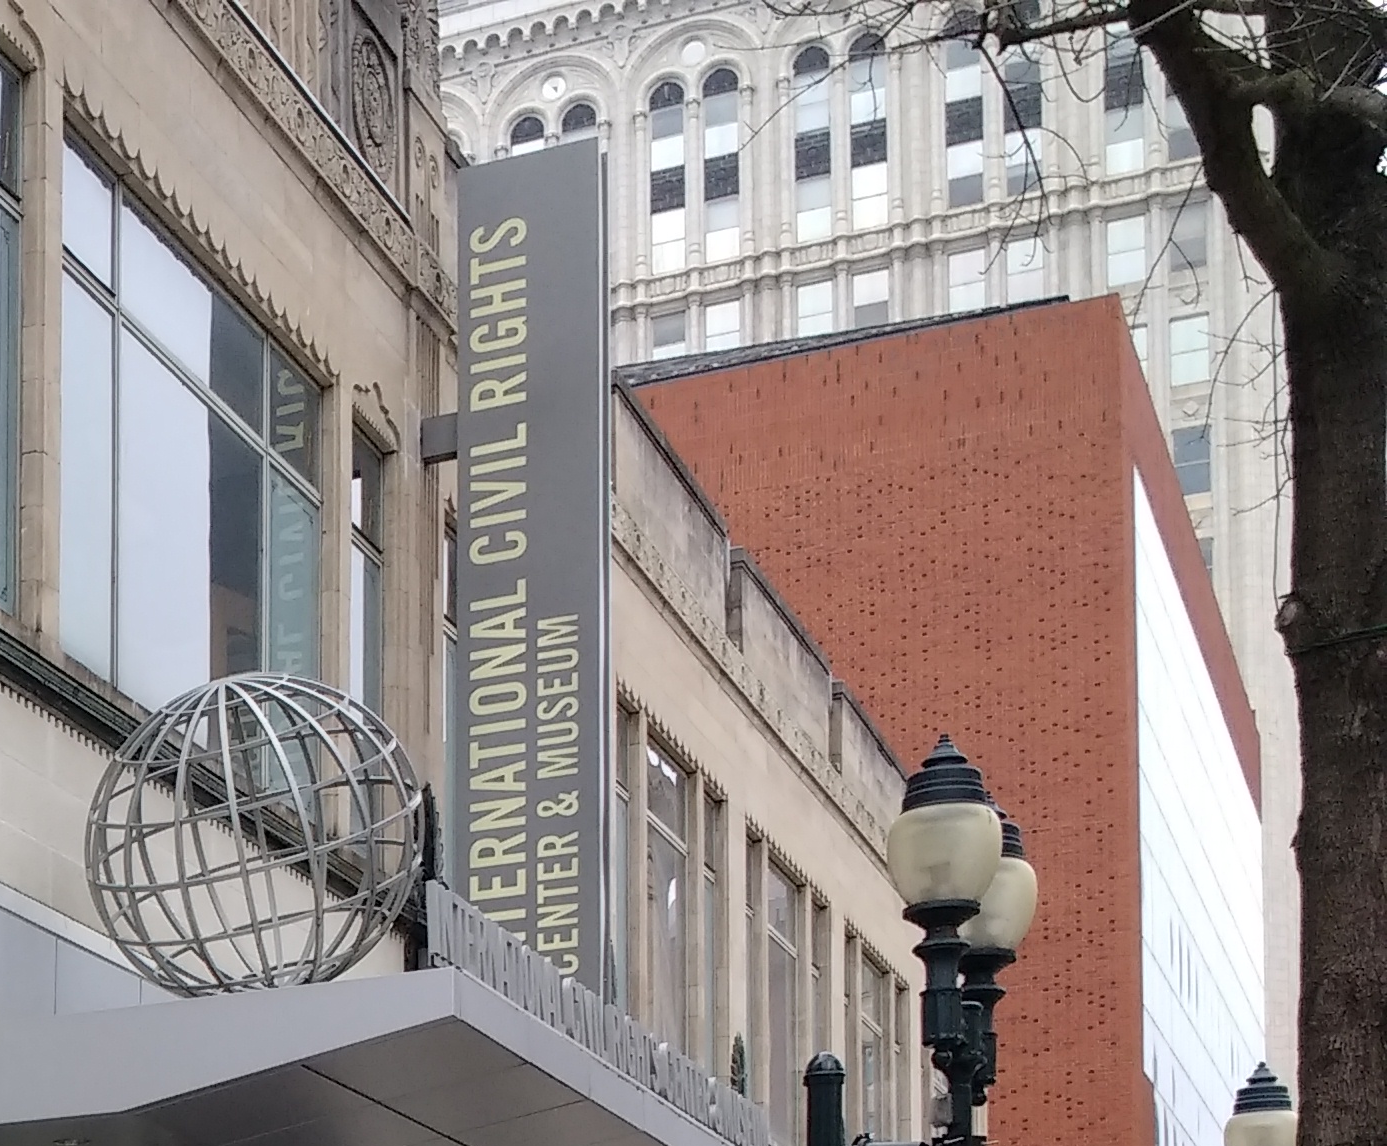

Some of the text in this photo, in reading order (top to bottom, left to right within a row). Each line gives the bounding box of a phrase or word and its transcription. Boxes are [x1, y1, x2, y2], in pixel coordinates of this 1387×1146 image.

[469, 216, 528, 412] RIGHTS
[469, 421, 528, 566] CIVIL
[536, 612, 580, 780] MUSEUM
[535, 789, 580, 819] &
